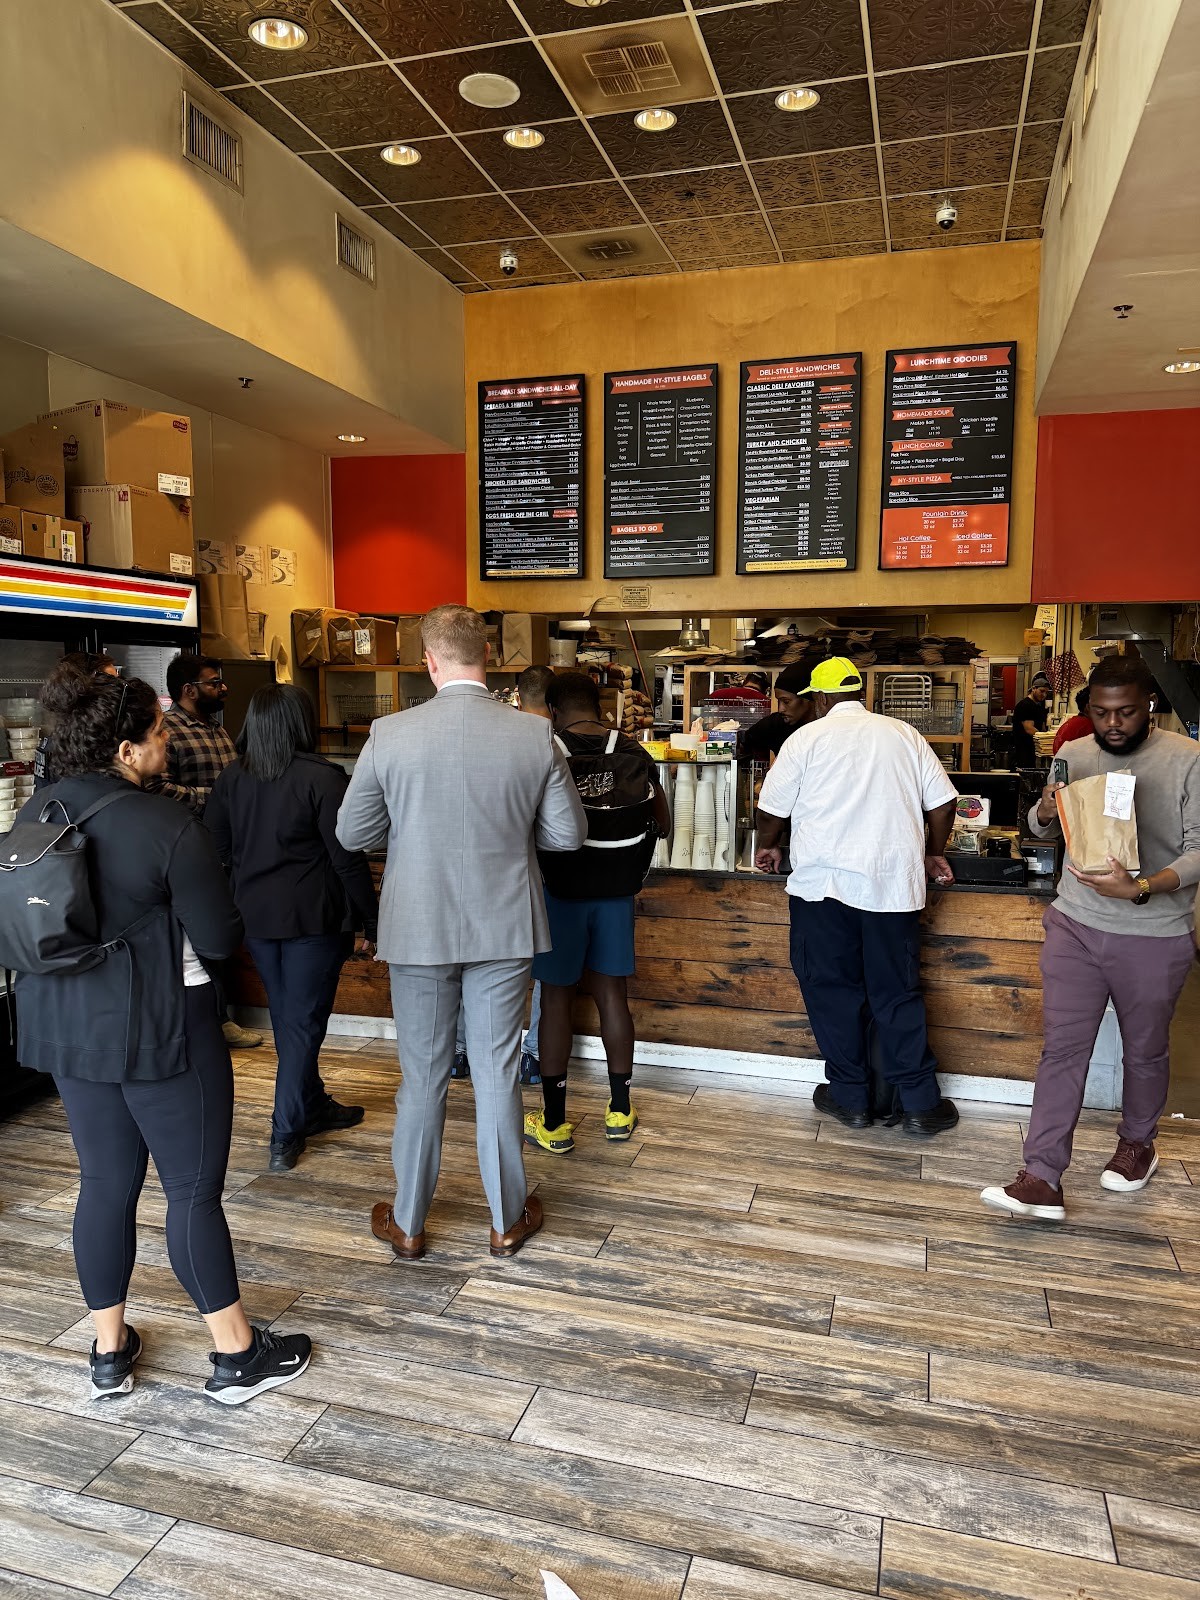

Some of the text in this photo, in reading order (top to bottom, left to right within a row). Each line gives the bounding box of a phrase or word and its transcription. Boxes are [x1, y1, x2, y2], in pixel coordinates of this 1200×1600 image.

[911, 355, 988, 366] LUNCHTIME GOODIES
[760, 367, 794, 376] DELI-STYLE
[795, 364, 840, 374] SANDWICHES
[615, 378, 652, 388] HANDMADE
[654, 376, 681, 385] NY-STYLE
[683, 374, 707, 382] BAGELS
[747, 384, 771, 392] CLASSIC
[784, 381, 815, 389] FAVORITES
[488, 389, 516, 397] BREAKFAST
[517, 386, 553, 395] SANDWICHES
[554, 384, 576, 392] ALL-DAY
[897, 411, 932, 419] HOMEMADE
[781, 438, 807, 447] CHICKEN
[921, 441, 945, 449] COMBO
[745, 496, 780, 504] VEGETARIAN
